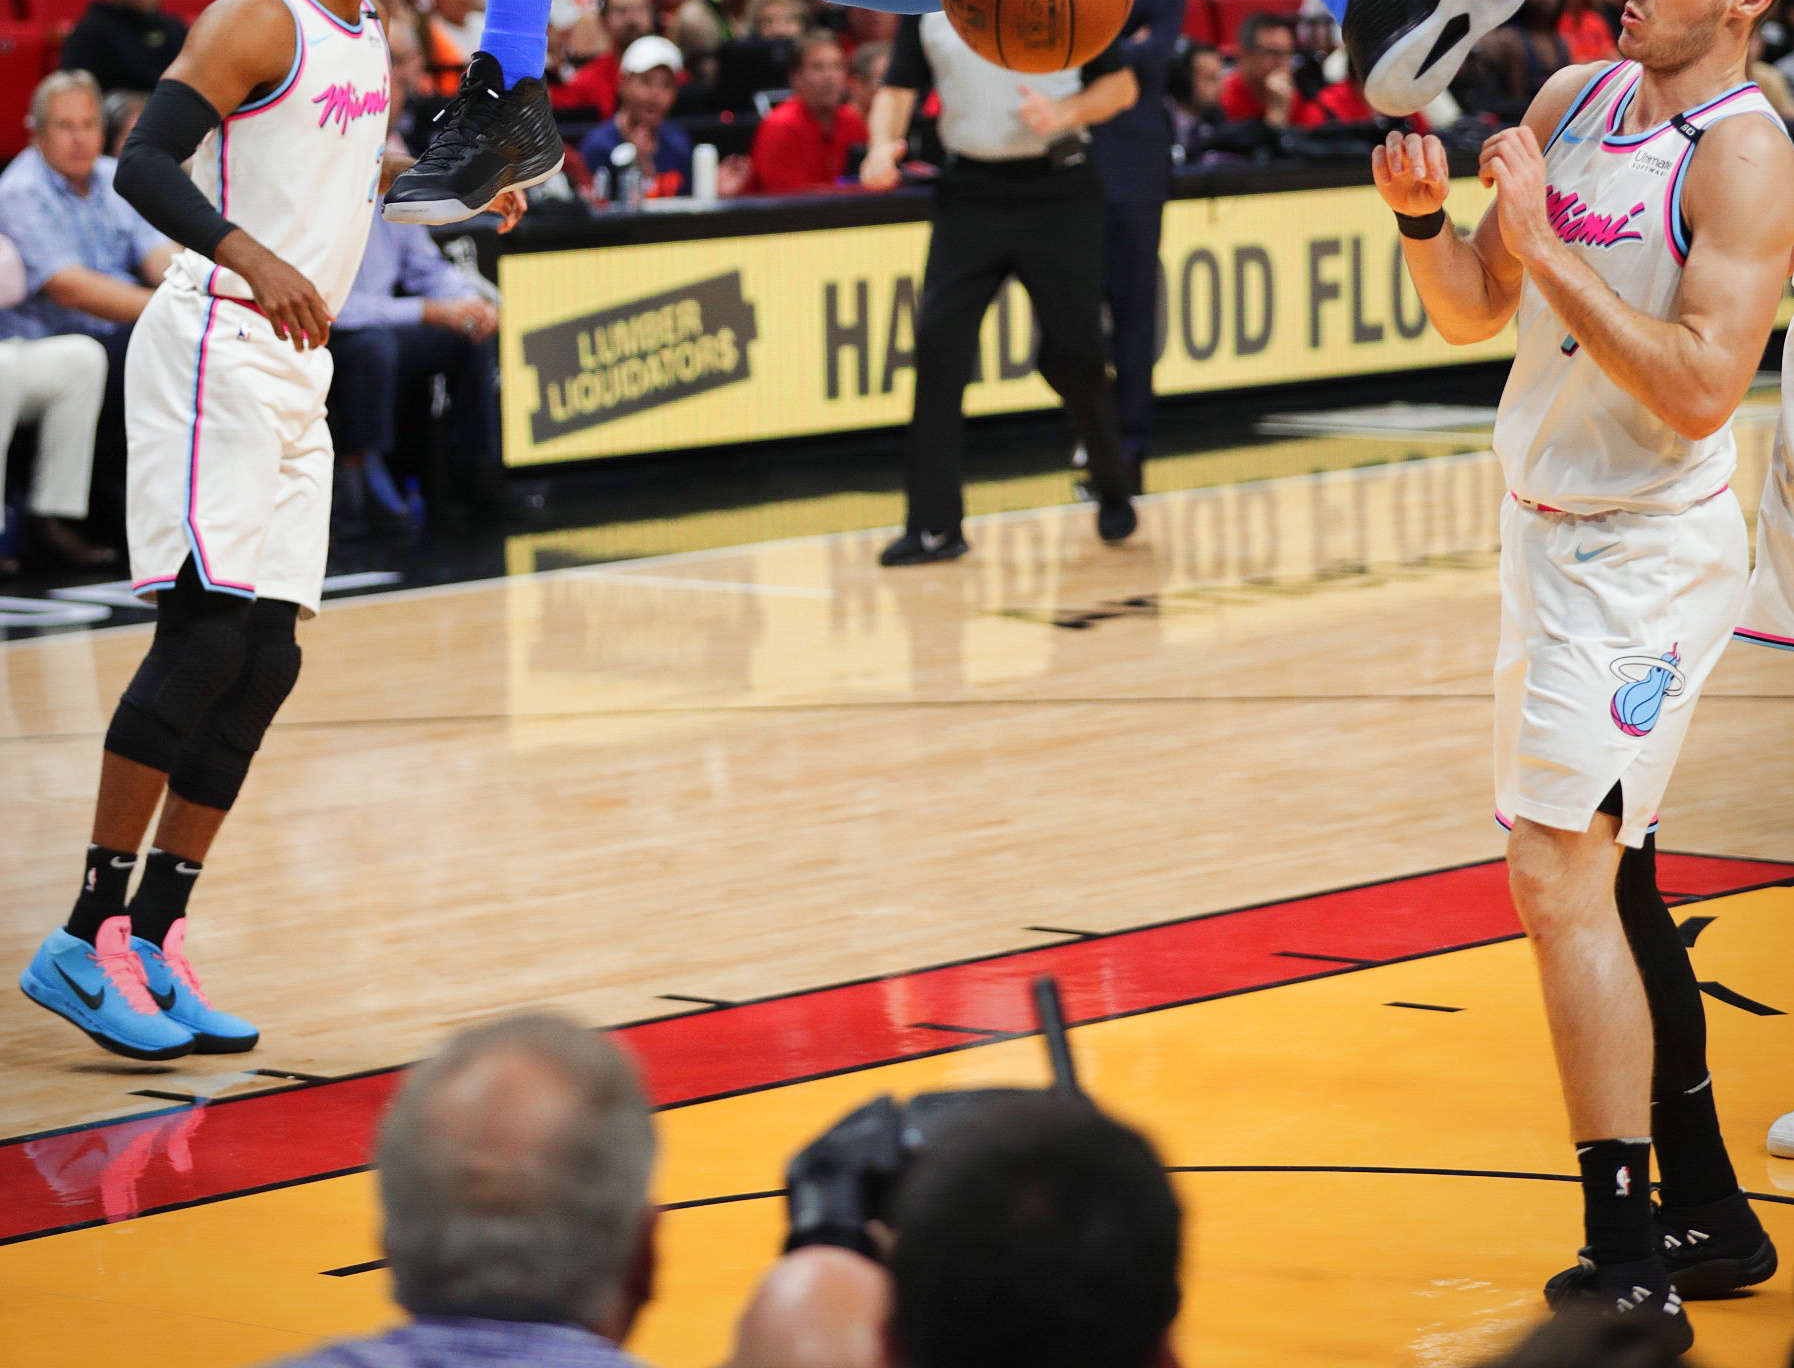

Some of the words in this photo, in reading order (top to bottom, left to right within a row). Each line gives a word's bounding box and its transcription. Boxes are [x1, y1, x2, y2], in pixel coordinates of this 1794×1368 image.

[312, 74, 389, 135] Miami
[1634, 150, 1673, 170] Ultimate
[576, 298, 704, 371] LUMBER
[547, 326, 740, 422] LIQUIDATORS
